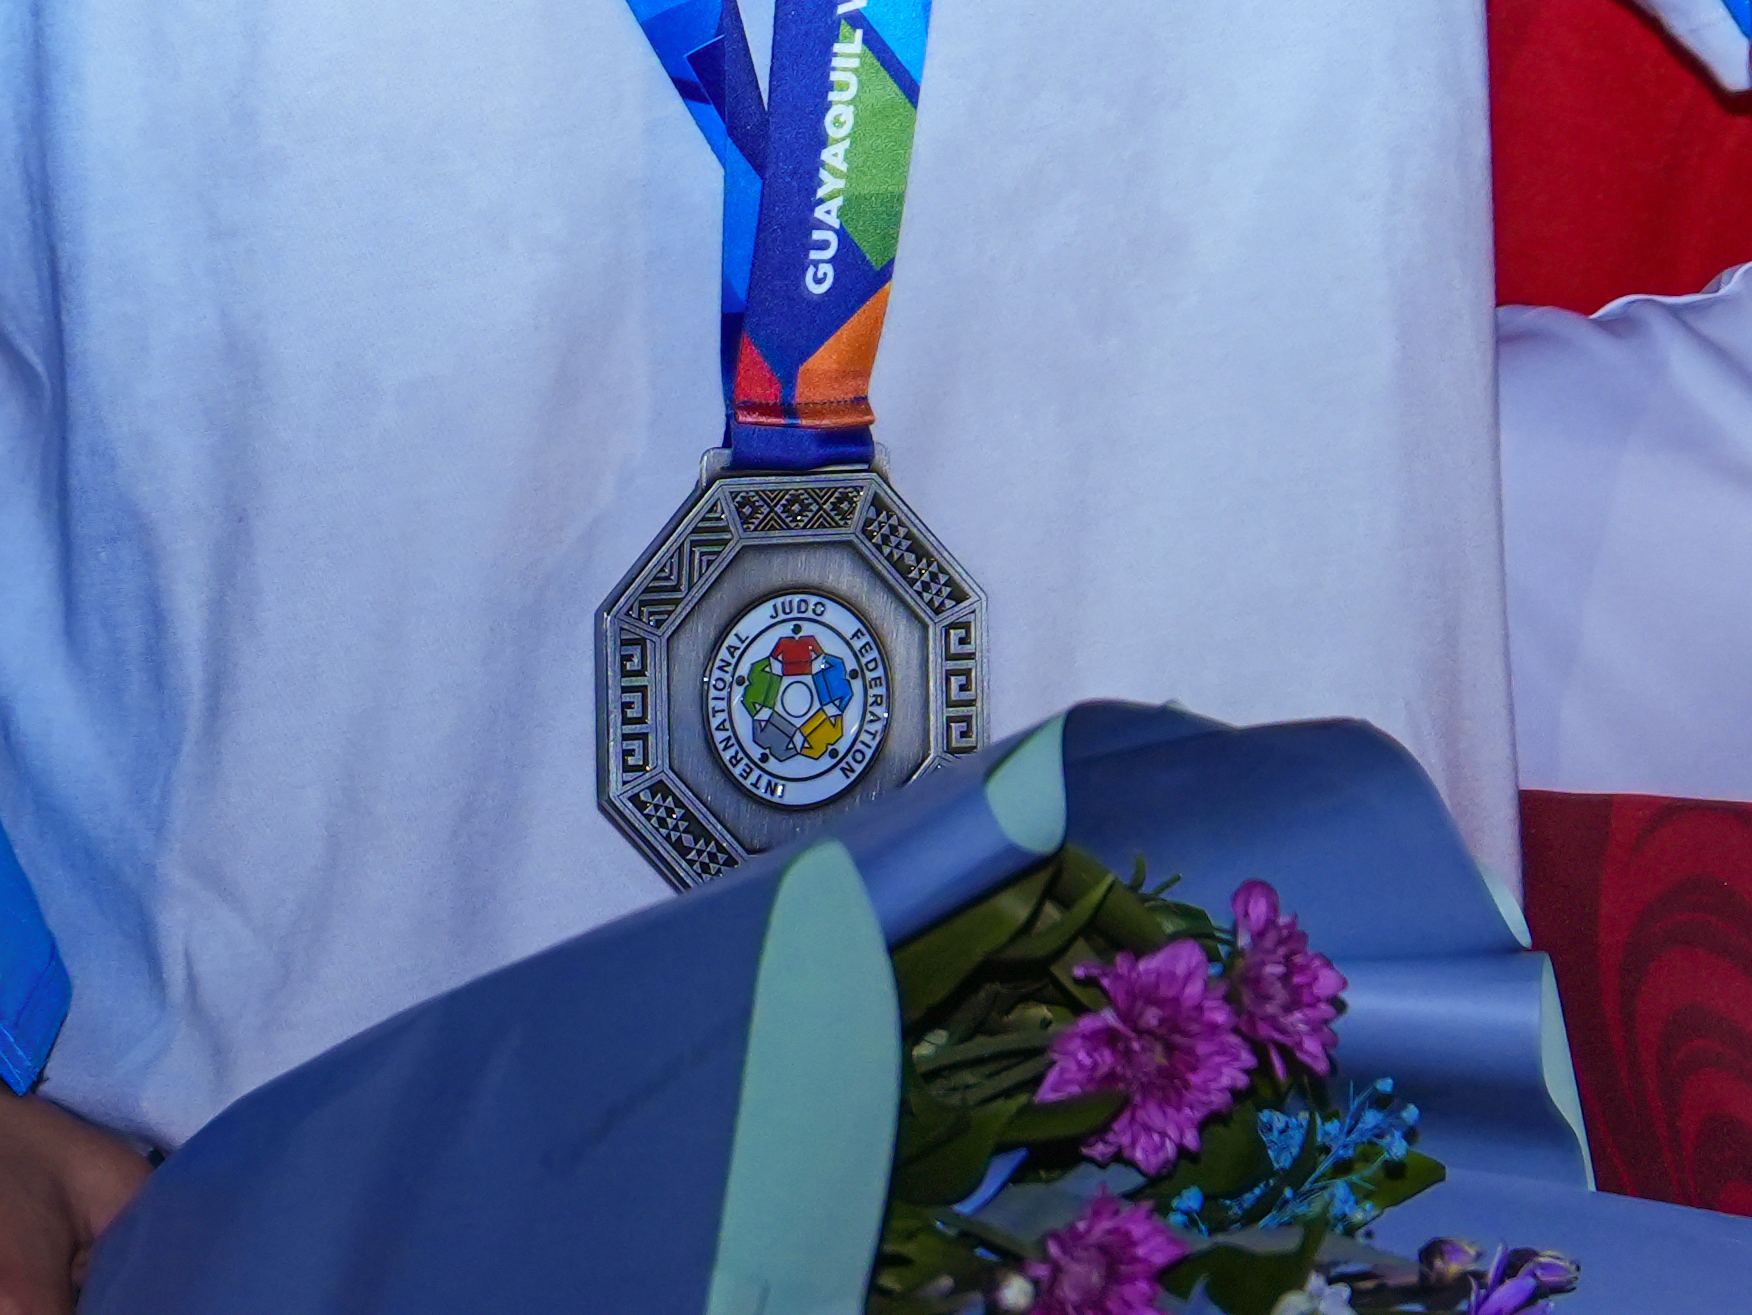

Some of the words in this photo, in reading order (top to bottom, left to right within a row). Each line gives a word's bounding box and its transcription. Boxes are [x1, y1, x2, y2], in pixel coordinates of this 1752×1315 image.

[805, 29, 863, 295] GUAYAQUIL
[711, 632, 785, 799] INTERNATIONAL
[769, 599, 827, 619] JUDO
[841, 627, 883, 779] FEDERATION
